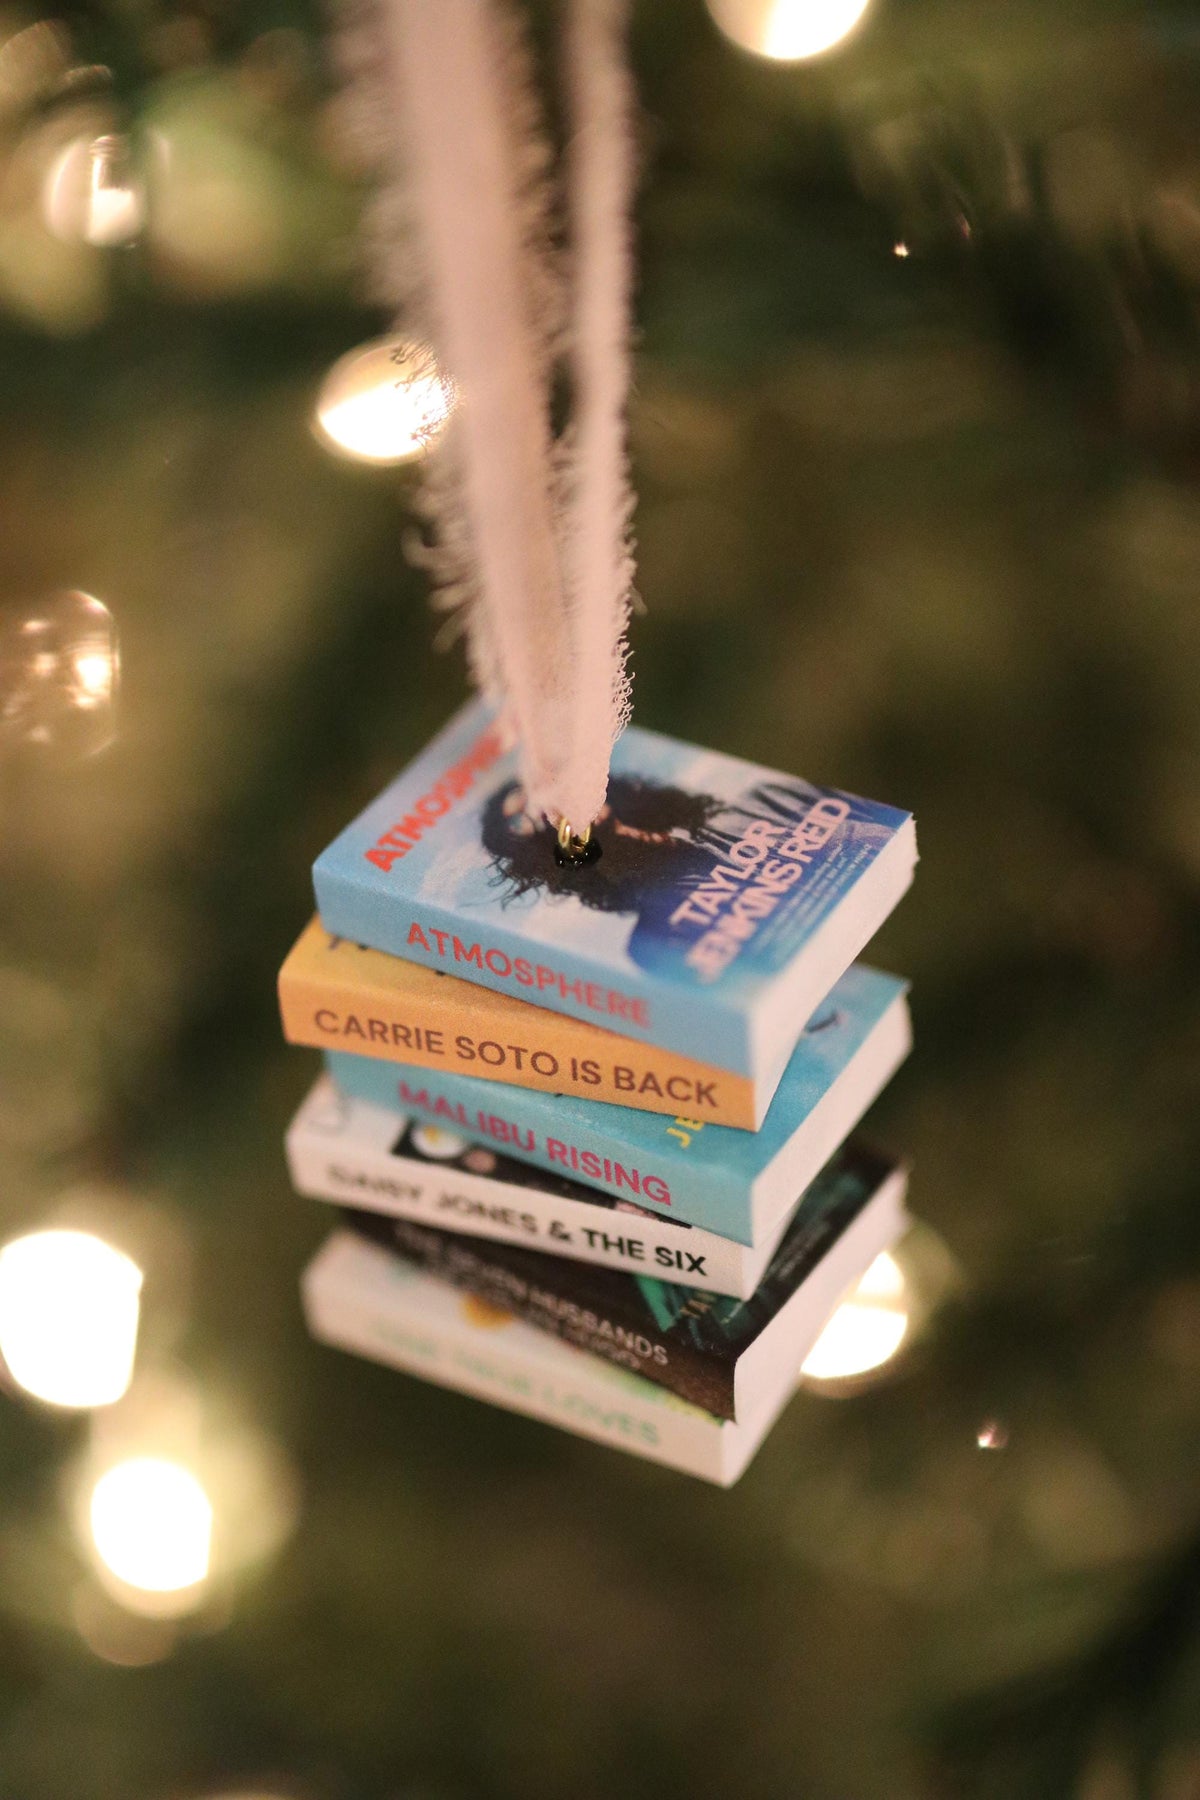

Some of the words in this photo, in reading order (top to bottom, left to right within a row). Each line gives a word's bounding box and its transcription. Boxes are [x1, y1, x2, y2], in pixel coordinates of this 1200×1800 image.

[669, 820, 788, 926] TAYLOR
[777, 798, 850, 864] REID
[406, 922, 652, 1028] ATMOSPHERE
[314, 1009, 446, 1055] CARRIE
[455, 1035, 559, 1077] SOTO
[571, 1057, 602, 1086] IS
[612, 1066, 718, 1108] BACK
[399, 1078, 536, 1151] MALIBU
[546, 1136, 672, 1206] RISING
[549, 1220, 575, 1243] &
[582, 1227, 645, 1261] THE
[656, 1246, 708, 1277] SIX
